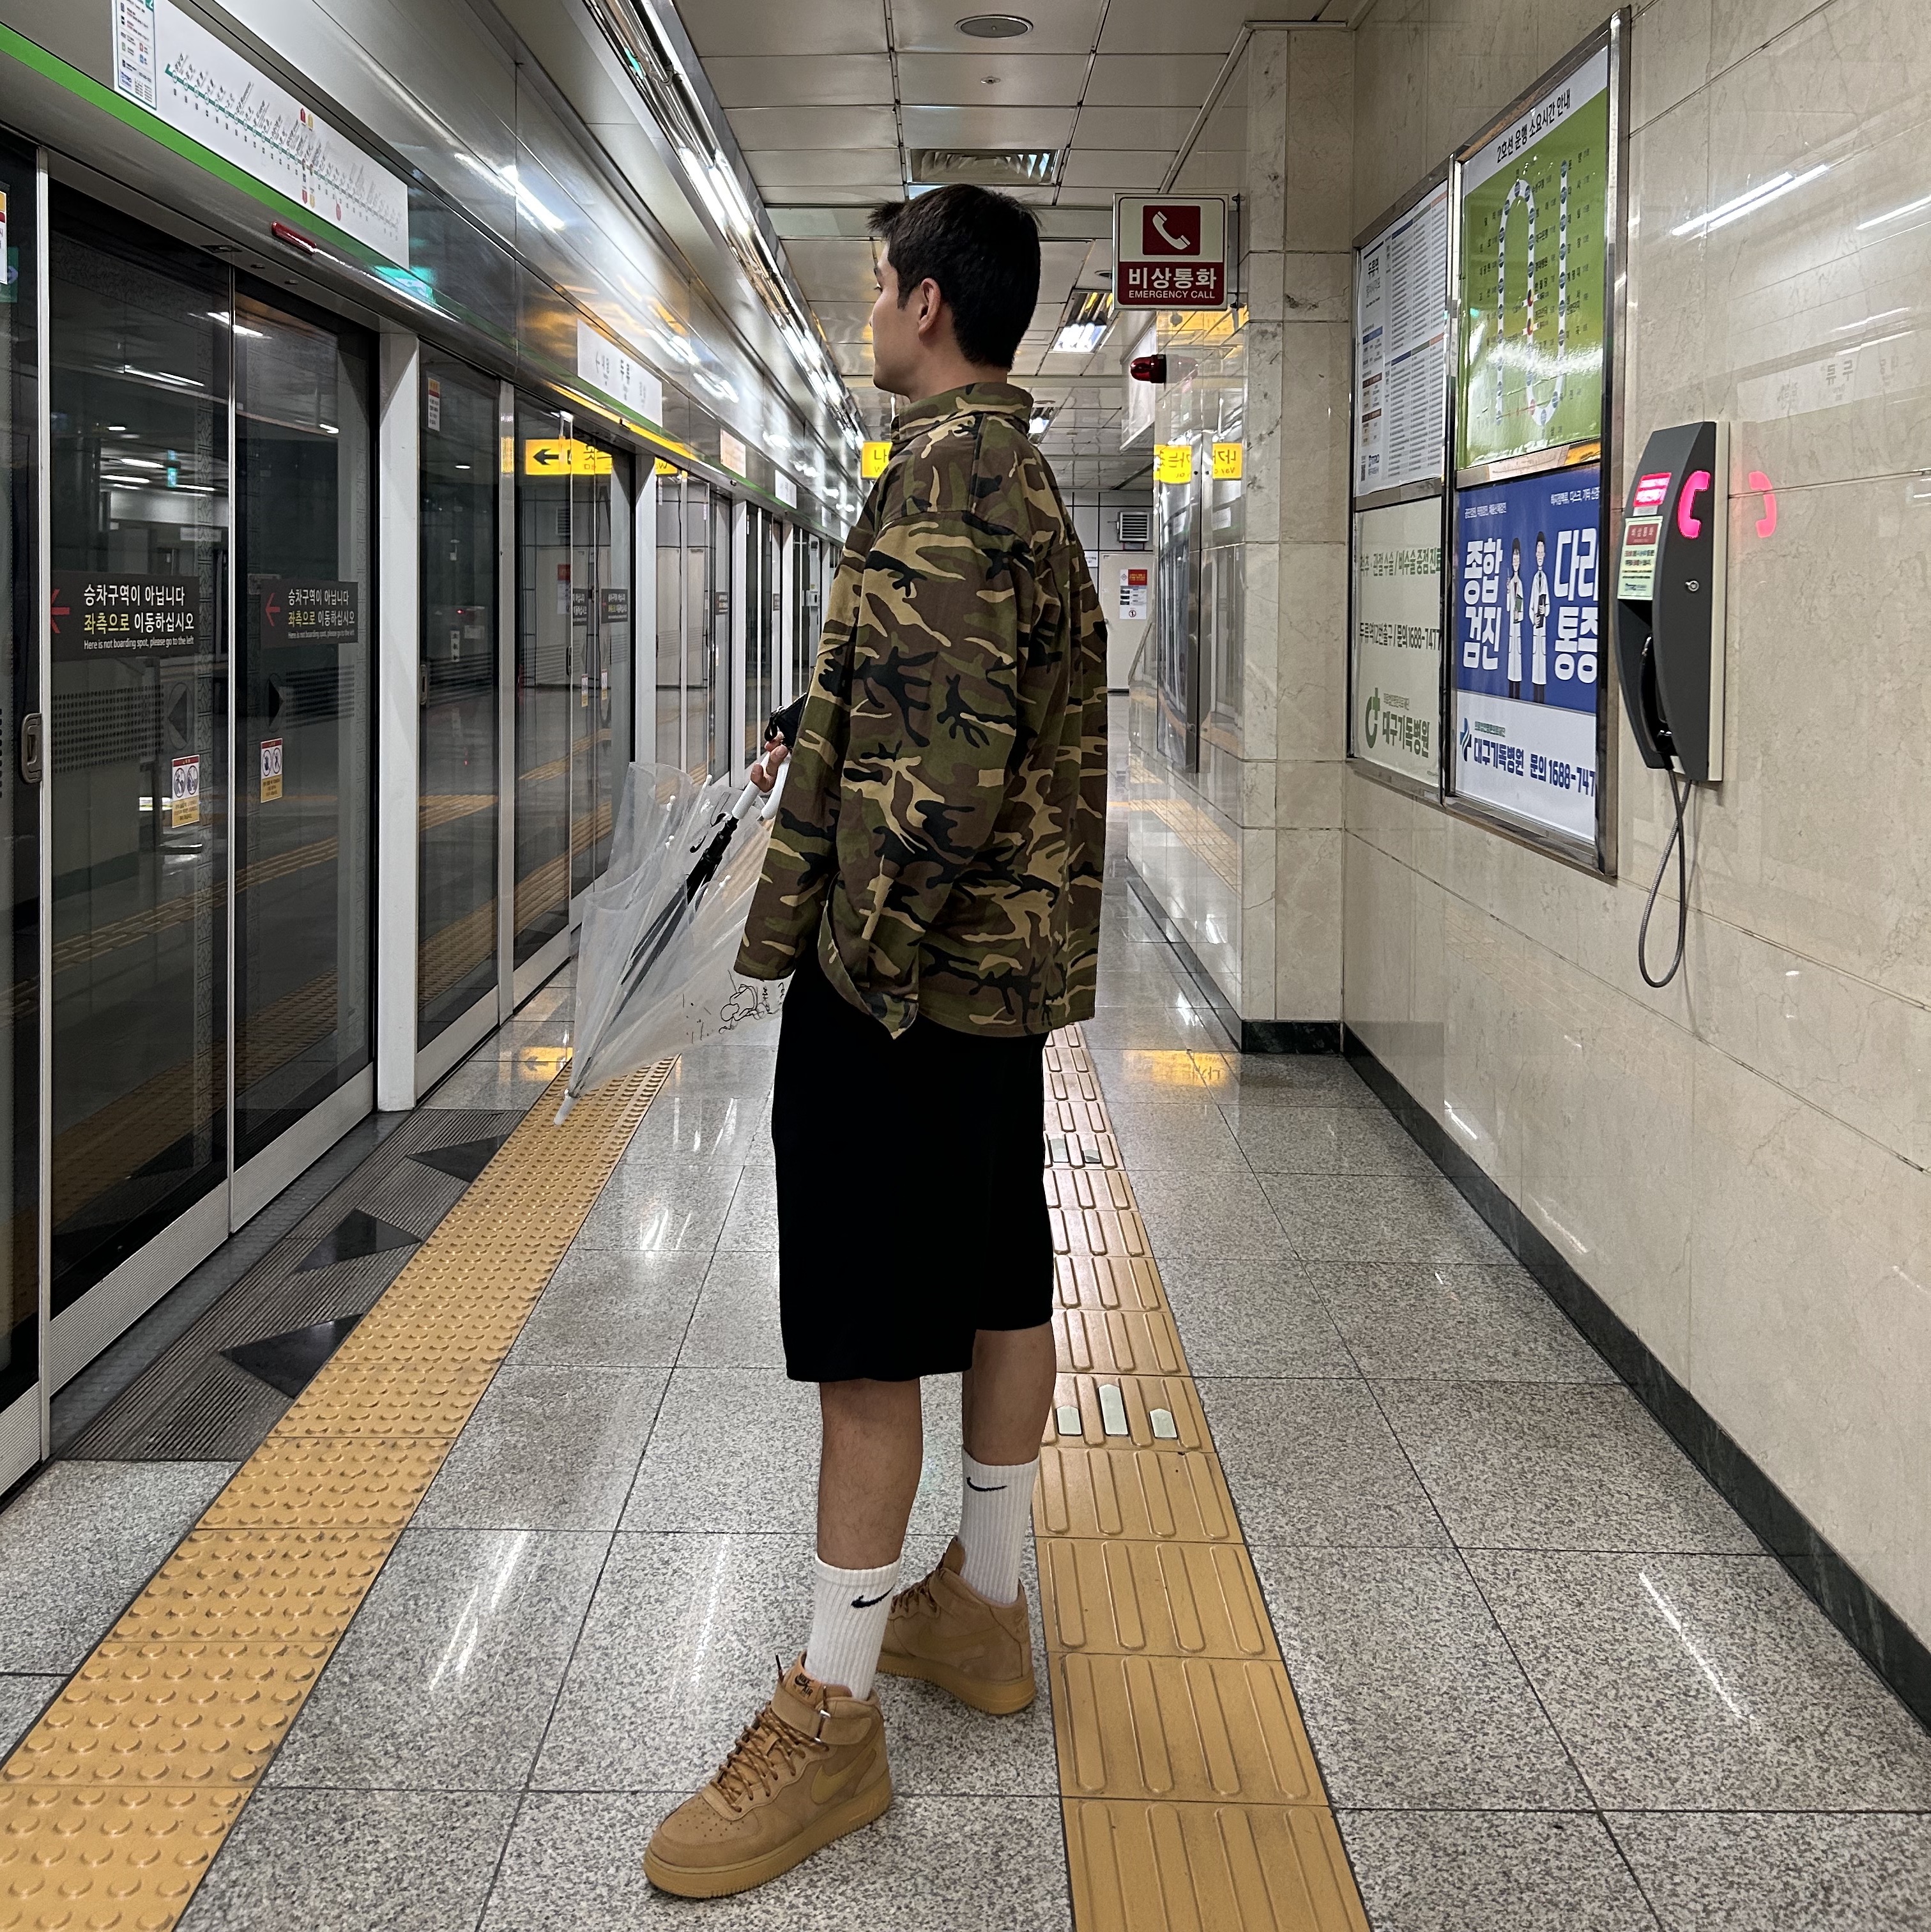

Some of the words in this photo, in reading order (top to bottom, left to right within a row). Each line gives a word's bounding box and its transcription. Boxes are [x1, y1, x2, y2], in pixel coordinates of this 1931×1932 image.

[1497, 135, 1513, 163] 2호선
[1515, 124, 1527, 150] 운행
[1529, 102, 1555, 137] 소요시간
[1557, 88, 1570, 118] 안내
[1128, 267, 1217, 289] 비상통화
[1129, 290, 1189, 298] EMERGENCY
[1464, 538, 1503, 605] 종합
[84, 584, 141, 606] 승차구역이
[145, 585, 185, 606] 아닙니다
[288, 588, 322, 606] 승차구역이
[324, 589, 349, 606] 아닙니다
[84, 612, 130, 634] 좌측으로
[134, 612, 194, 633] 이동하십시오
[288, 610, 316, 627] 좌측으로
[317, 610, 355, 627] 이동하십시오
[84, 640, 97, 649] Here
[98, 640, 103, 649] is
[103, 639, 113, 648] not
[113, 637, 136, 650] boarding
[149, 636, 165, 648] please
[165, 638, 172, 648] go
[172, 637, 178, 645] to
[178, 636, 186, 645] the
[186, 635, 194, 645] left
[1463, 606, 1502, 670] 검진
[1554, 607, 1598, 684] 통증
[1382, 710, 1430, 758] 대구기독병원
[1474, 737, 1524, 777] 대구기독병원
[1530, 753, 1546, 782] 문의
